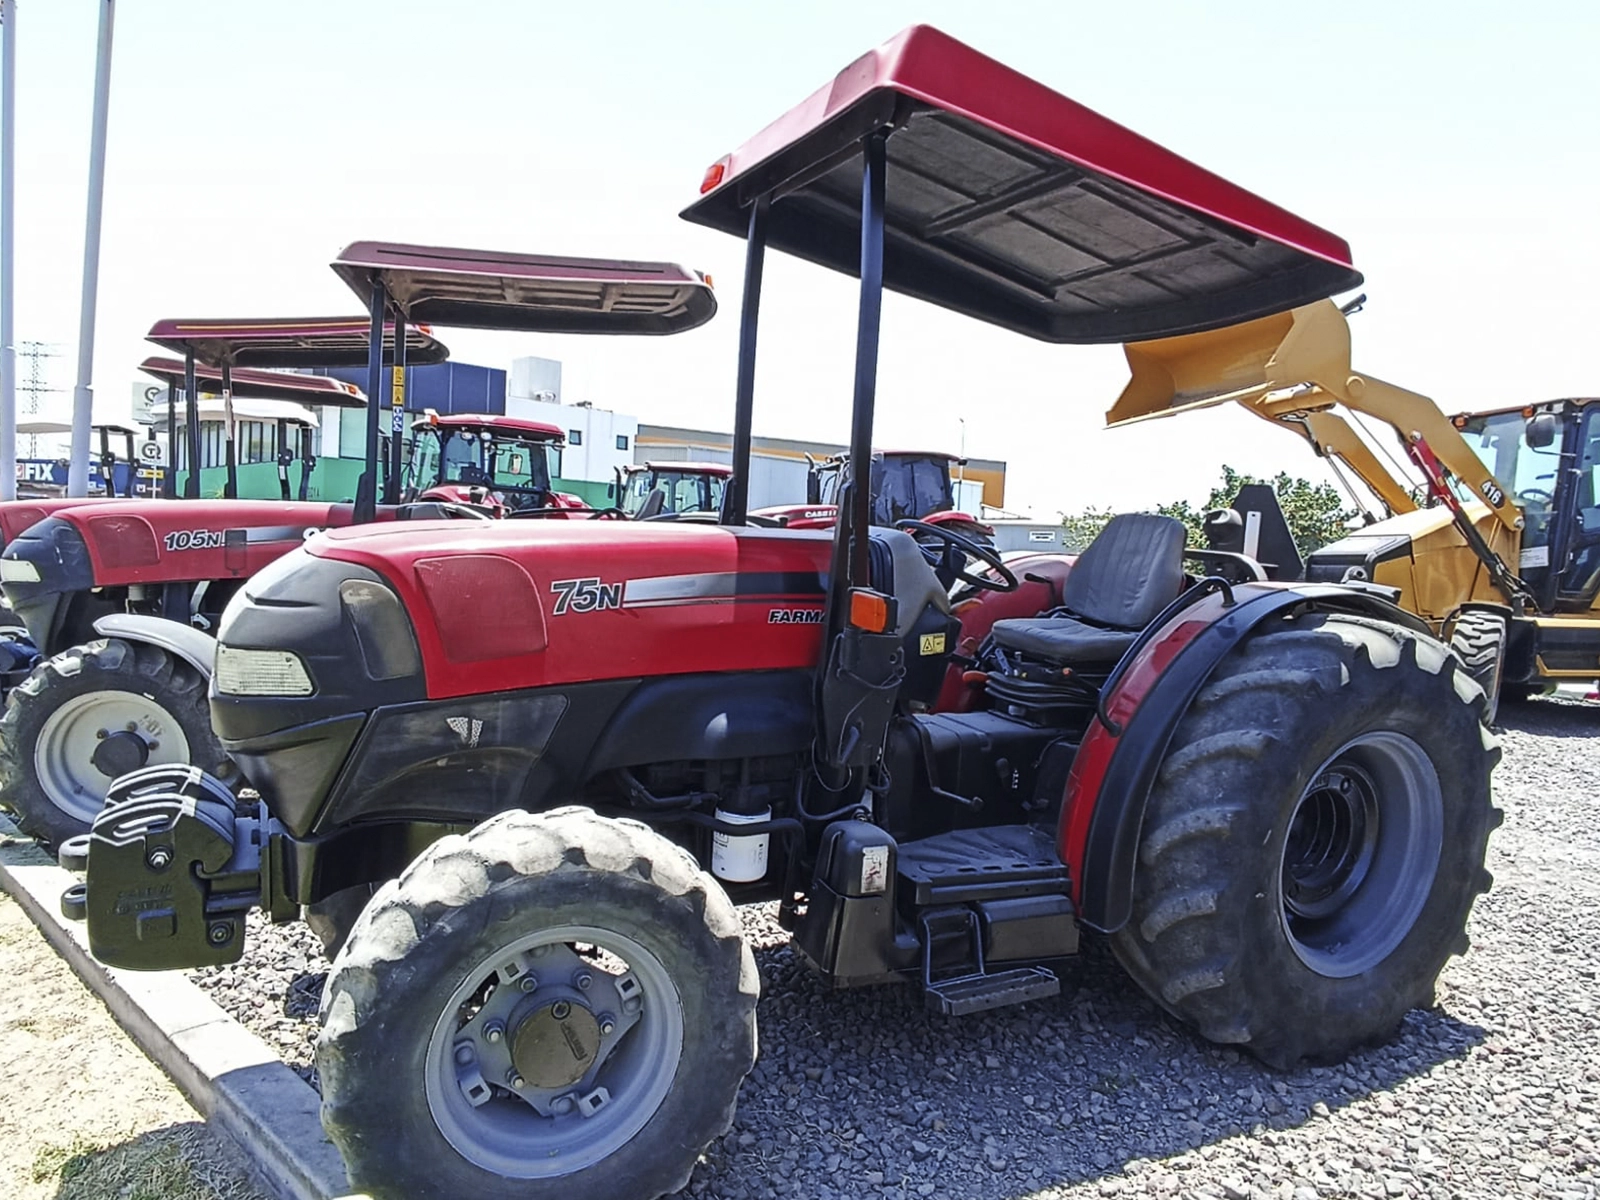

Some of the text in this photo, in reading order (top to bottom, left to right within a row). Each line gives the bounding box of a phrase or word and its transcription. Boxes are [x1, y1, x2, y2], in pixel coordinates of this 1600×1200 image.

[25, 463, 55, 481] FIX
[1482, 481, 1502, 504] 416
[164, 529, 221, 551] 105N
[550, 577, 623, 615] 75N
